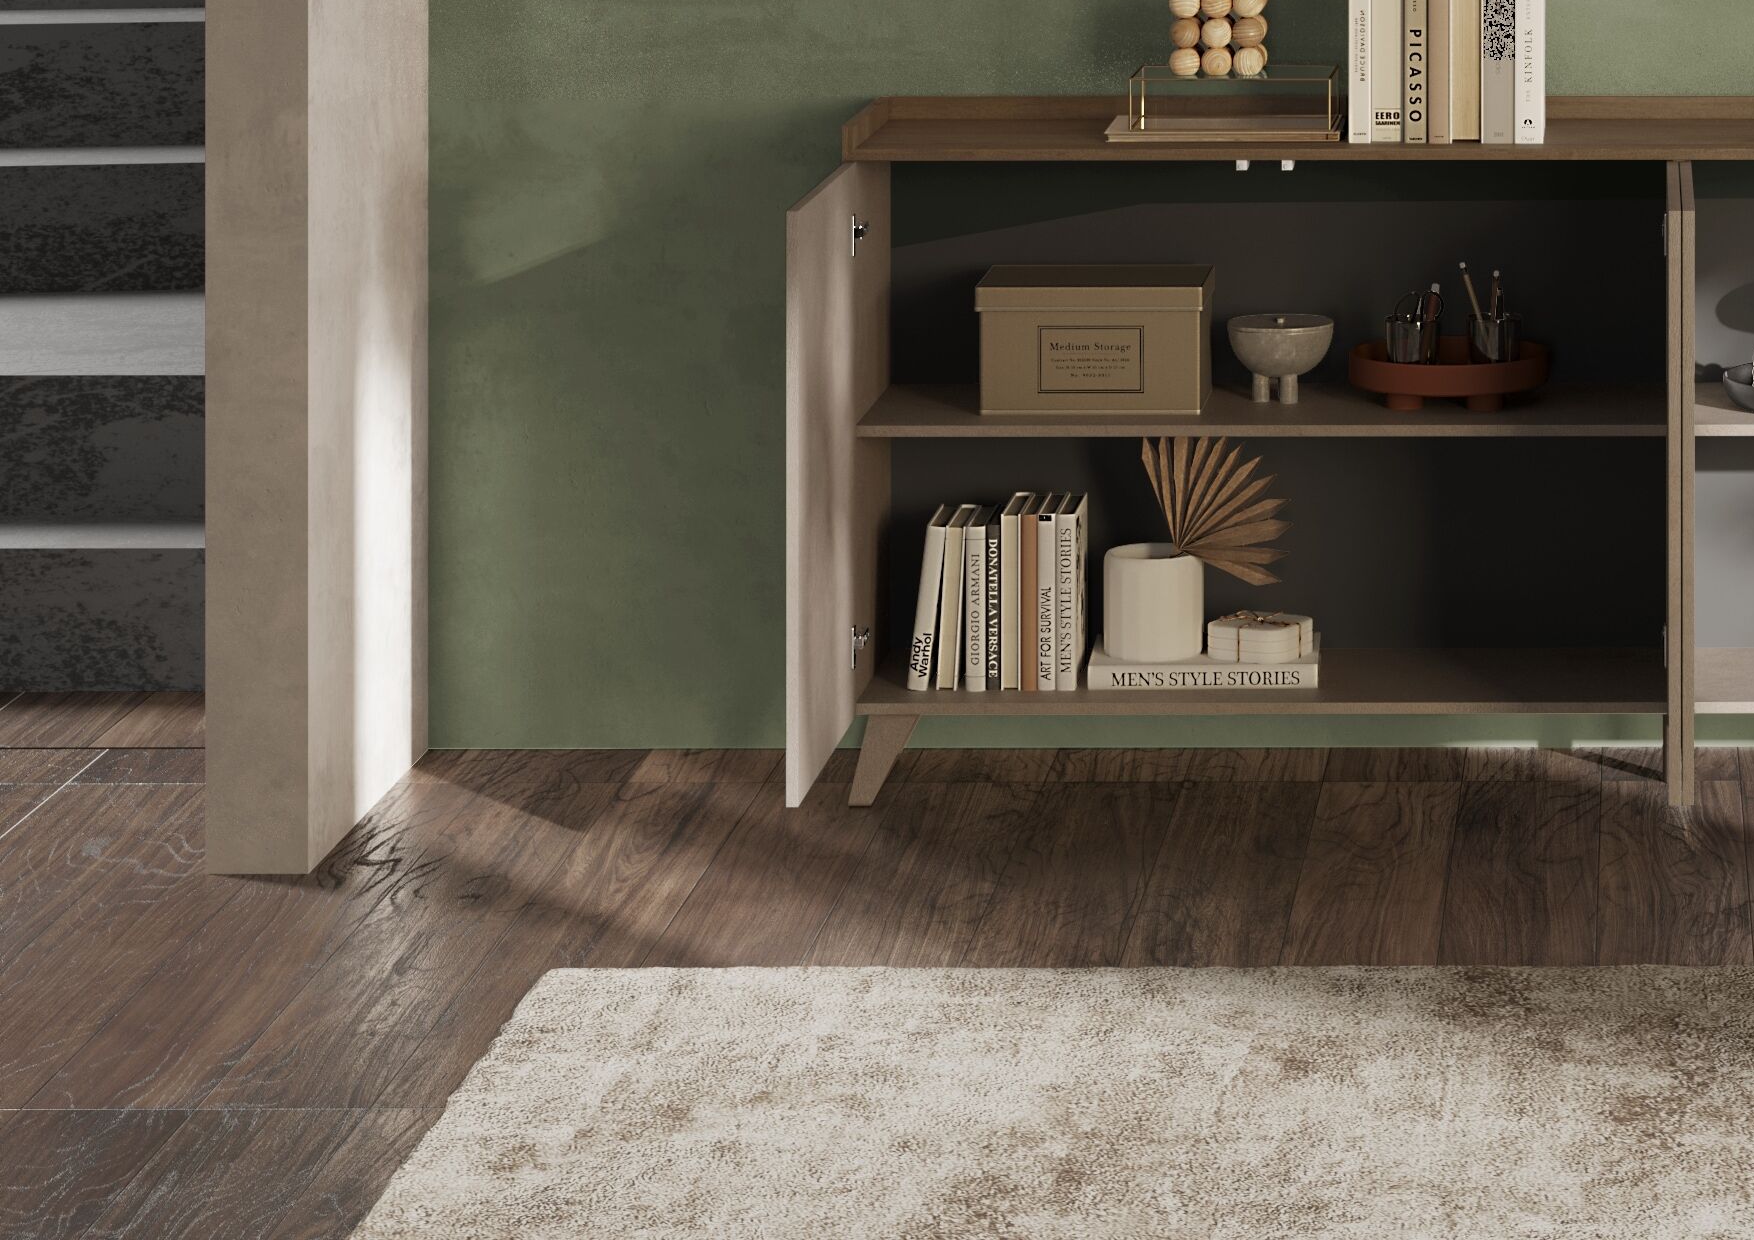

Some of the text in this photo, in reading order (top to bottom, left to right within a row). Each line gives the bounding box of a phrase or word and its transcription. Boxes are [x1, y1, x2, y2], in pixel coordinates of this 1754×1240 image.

[1409, 29, 1422, 123] PICASSO
[1524, 28, 1533, 84] KINFOLK
[1375, 111, 1400, 120] EERO
[1050, 342, 1132, 353] Medium Storage
[971, 553, 980, 666] GIORGIO ARMANI
[988, 538, 998, 678] DONATELLA VERSACE
[1060, 527, 1072, 673] MEN'S STYLE STORIES
[910, 636, 923, 672] Andy
[918, 632, 933, 678] Warhol
[1040, 586, 1051, 681] ART FOR SURVIVAL
[1111, 671, 1300, 687] MEN'S STYLE STORIES
